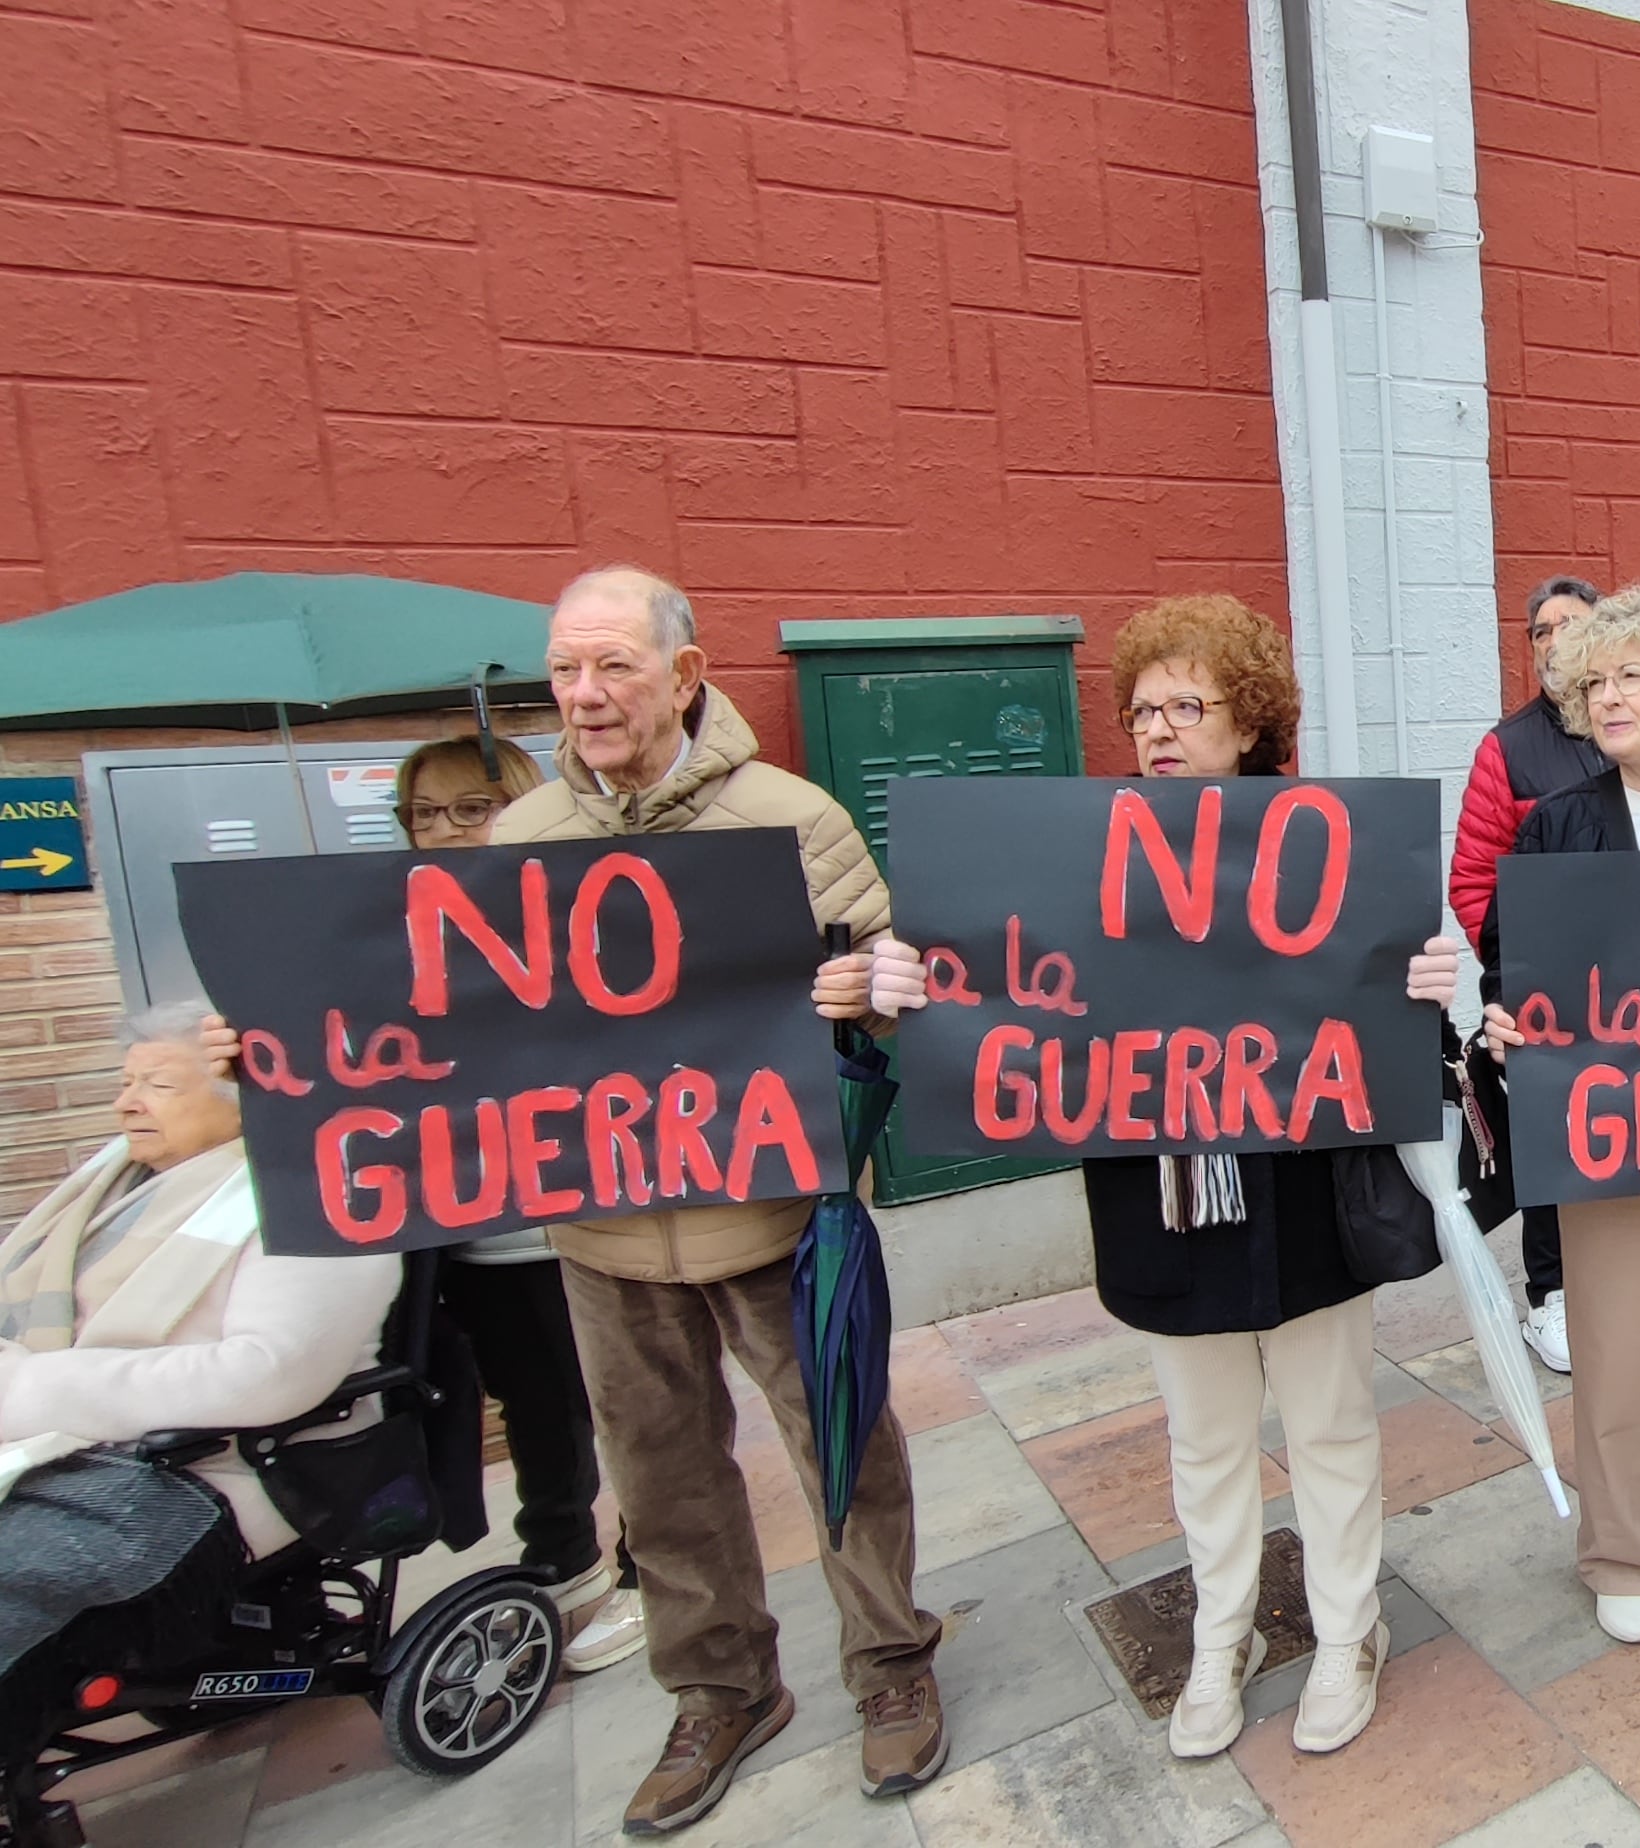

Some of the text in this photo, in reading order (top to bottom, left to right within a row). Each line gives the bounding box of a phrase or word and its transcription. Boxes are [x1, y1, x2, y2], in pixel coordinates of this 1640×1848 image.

[405, 852, 682, 1017] NO
[1101, 785, 1352, 957] NO
[924, 914, 1088, 1016] a la
[1515, 991, 1575, 1047] a
[241, 1008, 456, 1096] a la
[972, 1017, 1374, 1145] GUERRA
[313, 1067, 822, 1245] GUERRA
